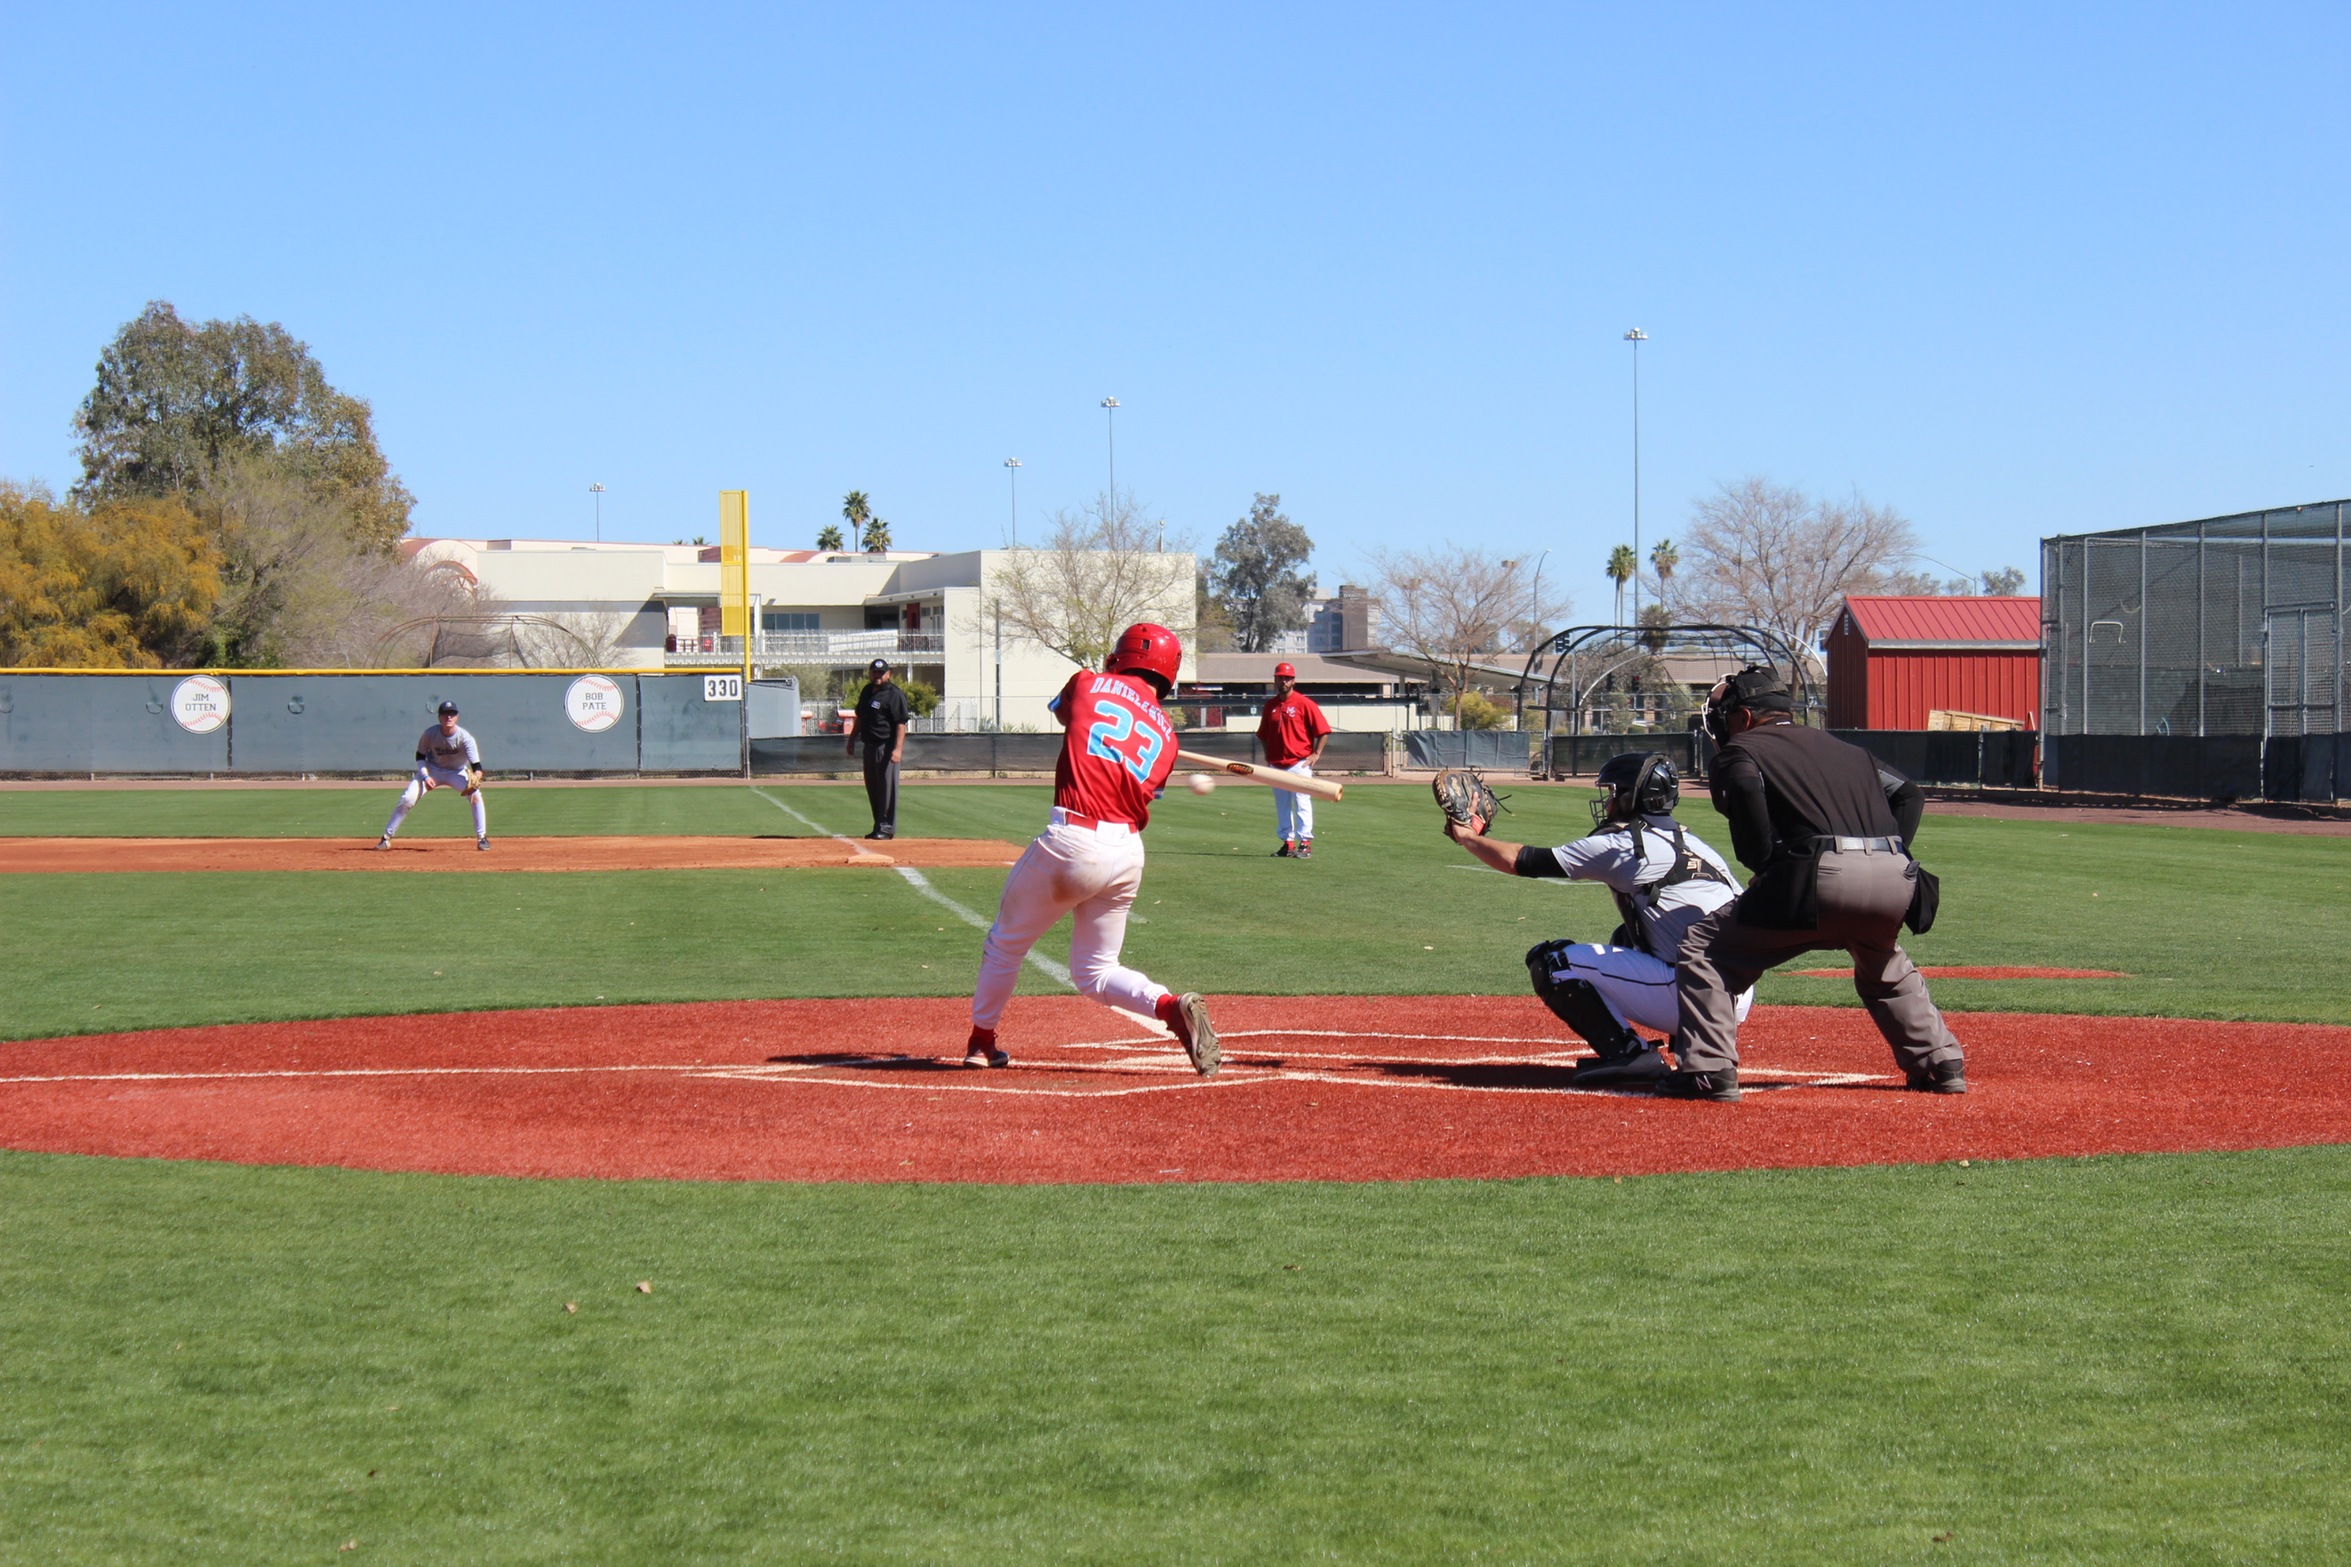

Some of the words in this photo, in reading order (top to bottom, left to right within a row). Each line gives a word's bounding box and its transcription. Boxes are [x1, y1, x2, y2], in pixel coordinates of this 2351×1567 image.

[708, 679, 738, 697] 330
[192, 693, 209, 702] JIM
[585, 692, 604, 701] BOB
[185, 703, 216, 711] OTTEN
[582, 702, 607, 710] PATE
[1086, 699, 1163, 784] 23
